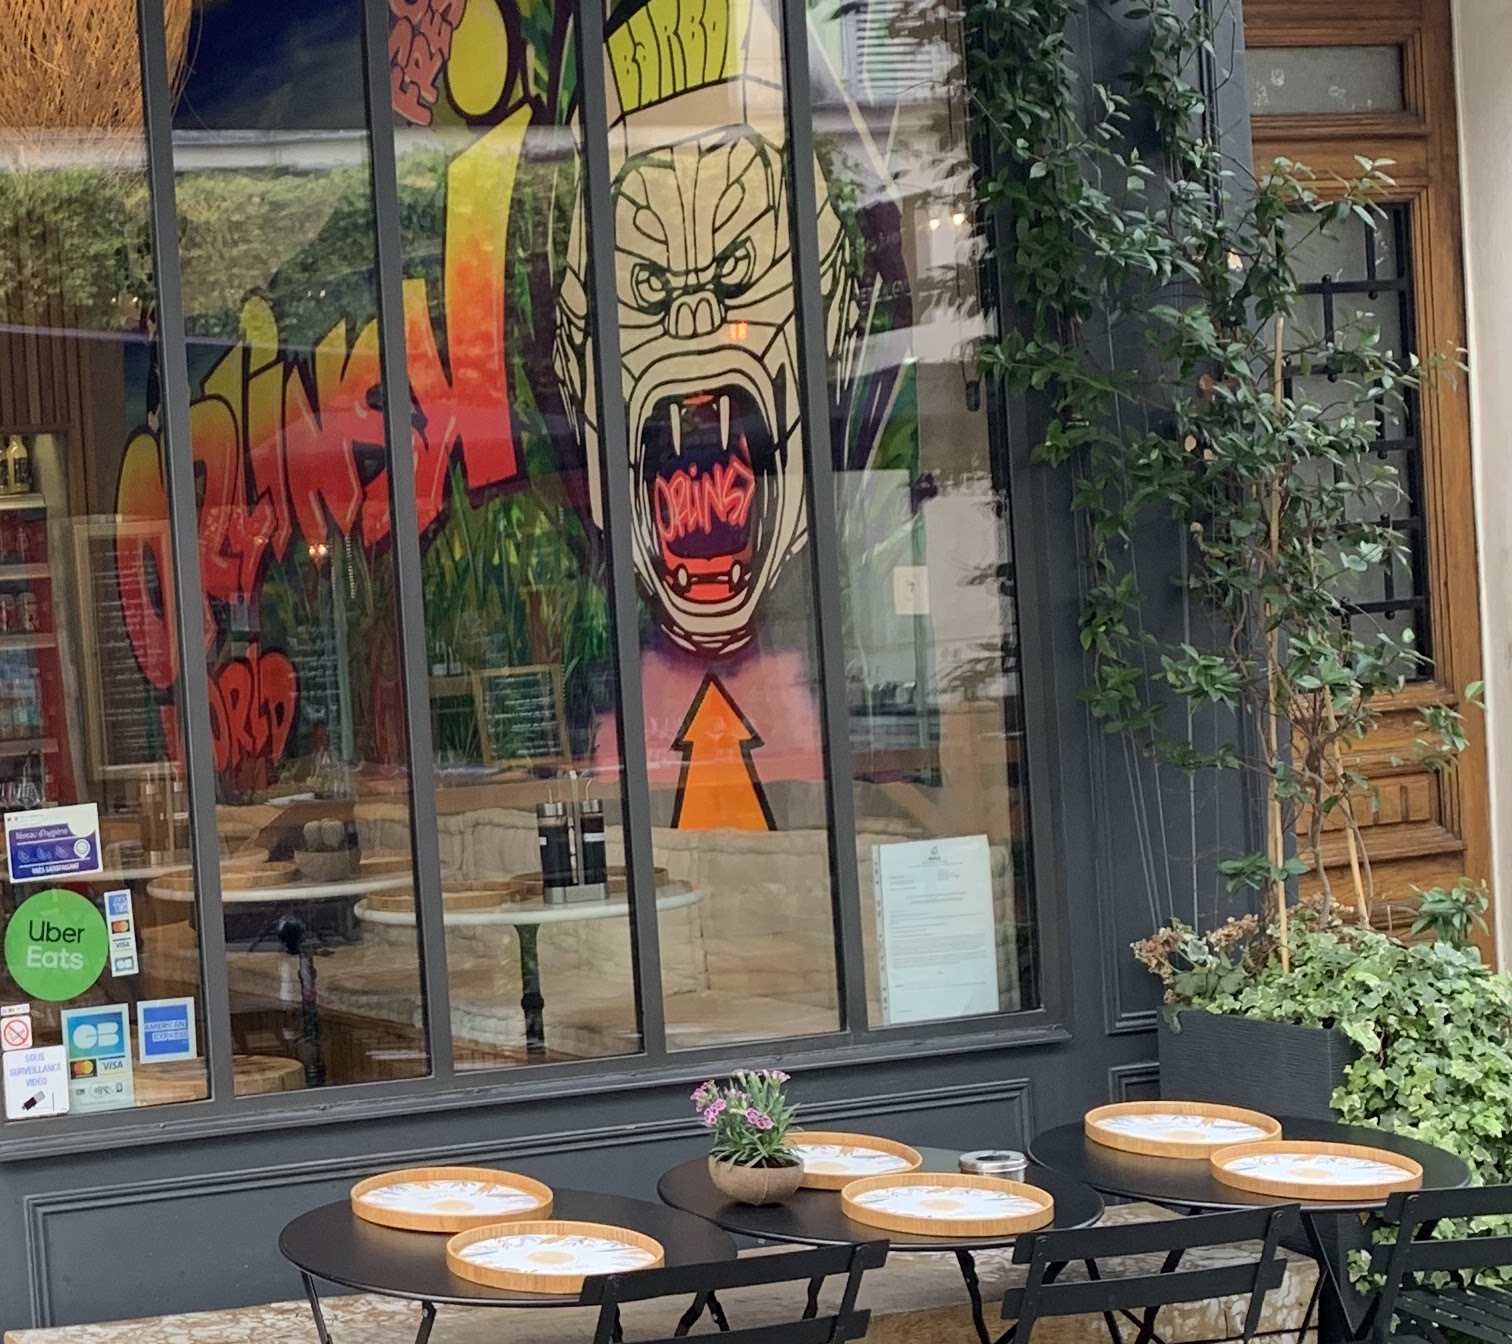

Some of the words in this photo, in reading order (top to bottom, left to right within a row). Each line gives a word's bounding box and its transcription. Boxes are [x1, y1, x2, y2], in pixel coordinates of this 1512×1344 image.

[29, 920, 85, 943] Uber
[26, 946, 84, 970] Eats
[145, 1021, 184, 1030] AMERICAN
[25, 1053, 44, 1062] SOUS
[10, 1063, 61, 1076] SURVEILLANCE
[103, 1060, 123, 1070] VISA
[26, 1077, 47, 1086] VIDEO
